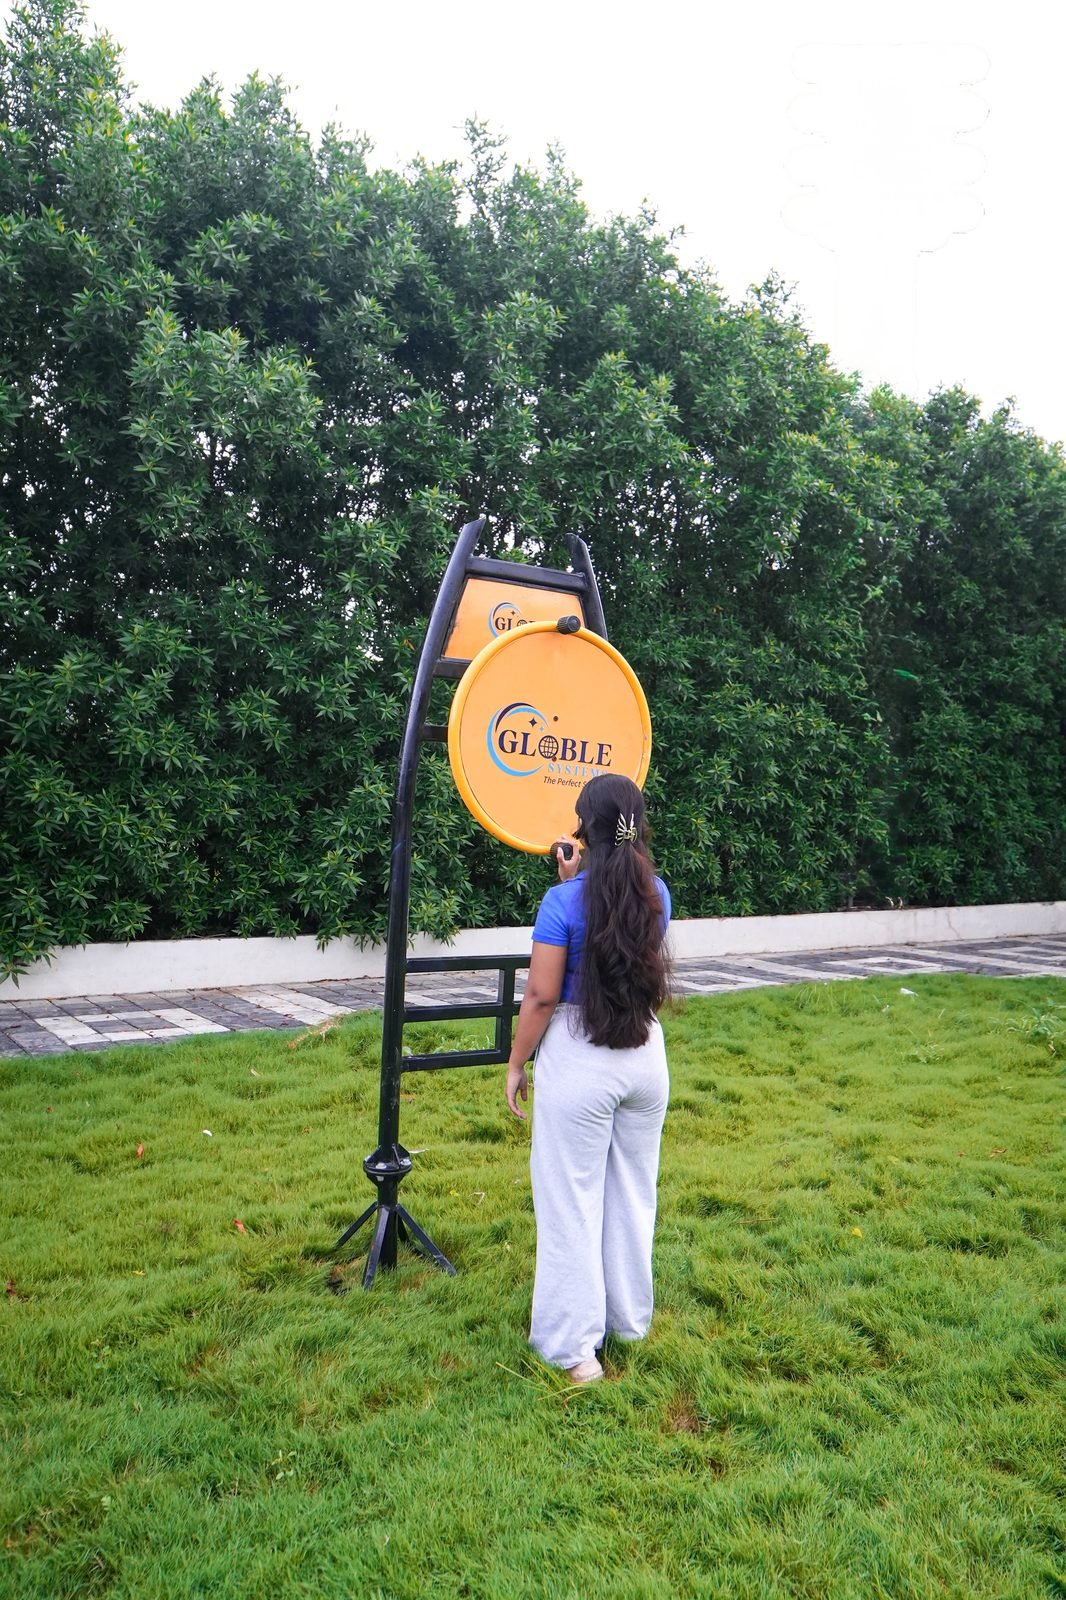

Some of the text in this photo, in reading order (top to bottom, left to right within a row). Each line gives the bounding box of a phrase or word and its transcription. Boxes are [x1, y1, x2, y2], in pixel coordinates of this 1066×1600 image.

[498, 729, 612, 767] GLOBLE
[543, 775, 556, 785] The
[557, 777, 581, 788] Perfect
